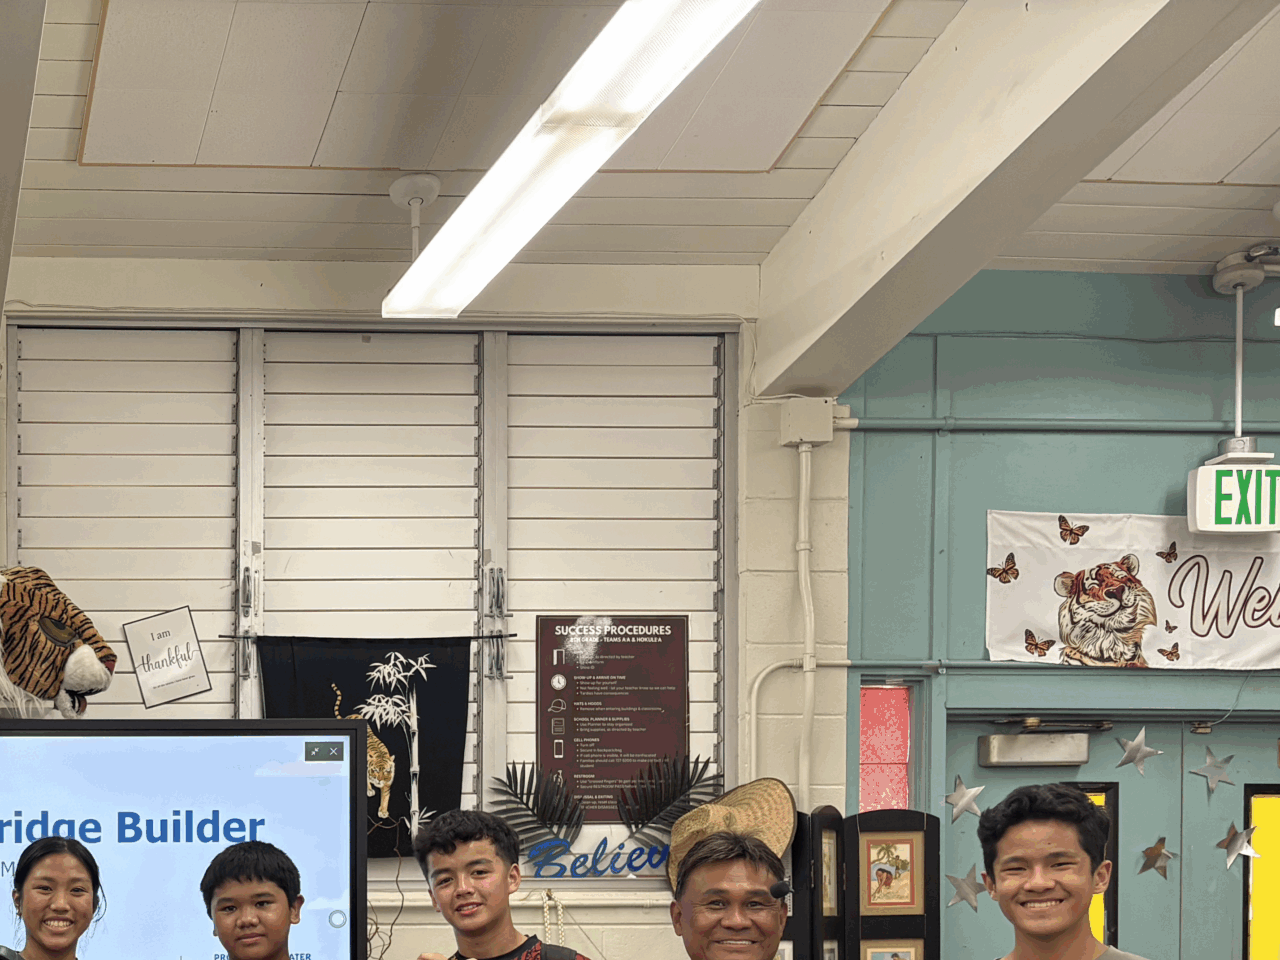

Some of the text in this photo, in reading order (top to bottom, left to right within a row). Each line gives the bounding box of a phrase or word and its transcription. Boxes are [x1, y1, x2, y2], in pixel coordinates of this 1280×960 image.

[1214, 469, 1280, 525] EXIT
[150, 630, 171, 641] I am
[554, 625, 672, 636] SUCCESS PROCEDURES
[139, 641, 195, 673] thankful
[117, 810, 266, 844] Builder
[525, 836, 670, 878] Believ
